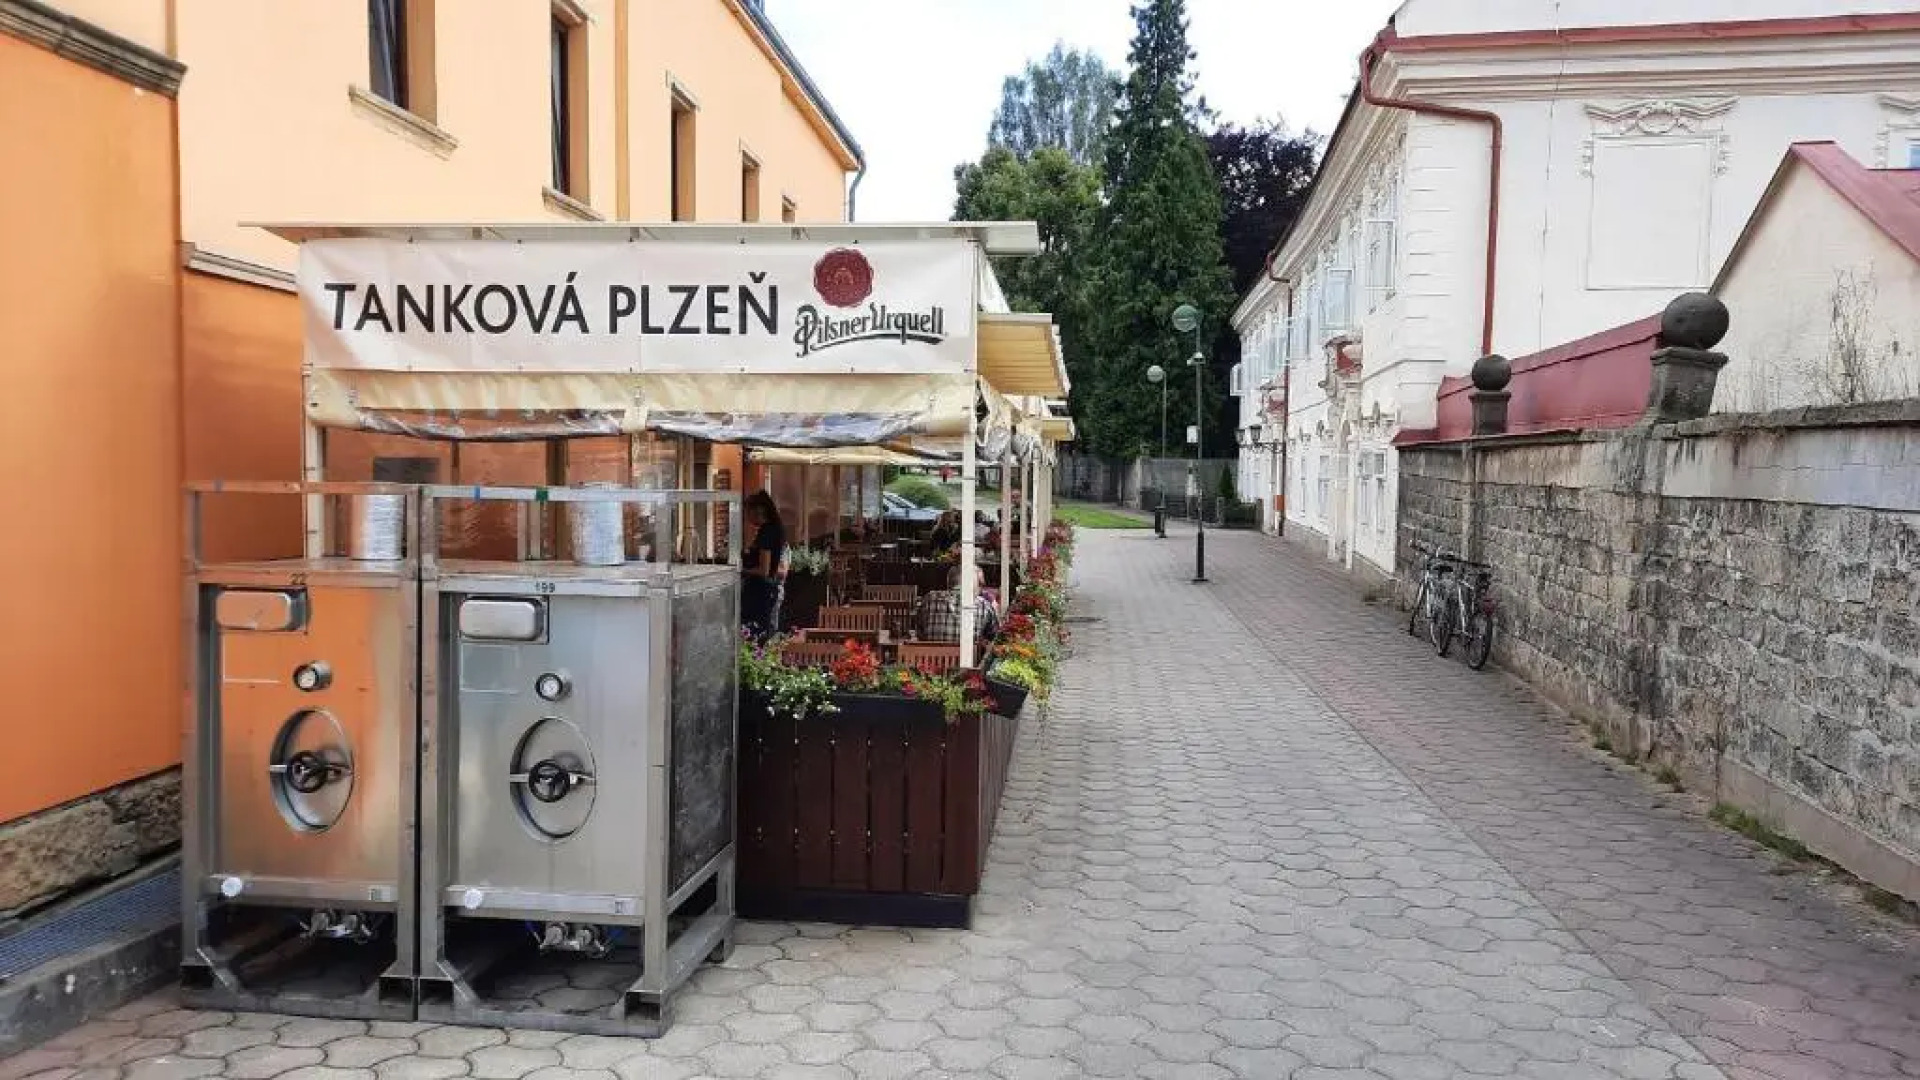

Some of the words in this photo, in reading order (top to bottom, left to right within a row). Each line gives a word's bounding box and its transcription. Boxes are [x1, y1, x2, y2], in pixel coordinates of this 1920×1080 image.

[324, 271, 590, 334] TANKOVÁ
[608, 271, 779, 335] PLZEŇ
[793, 304, 870, 358] Pilsner
[869, 302, 944, 345] Urquell
